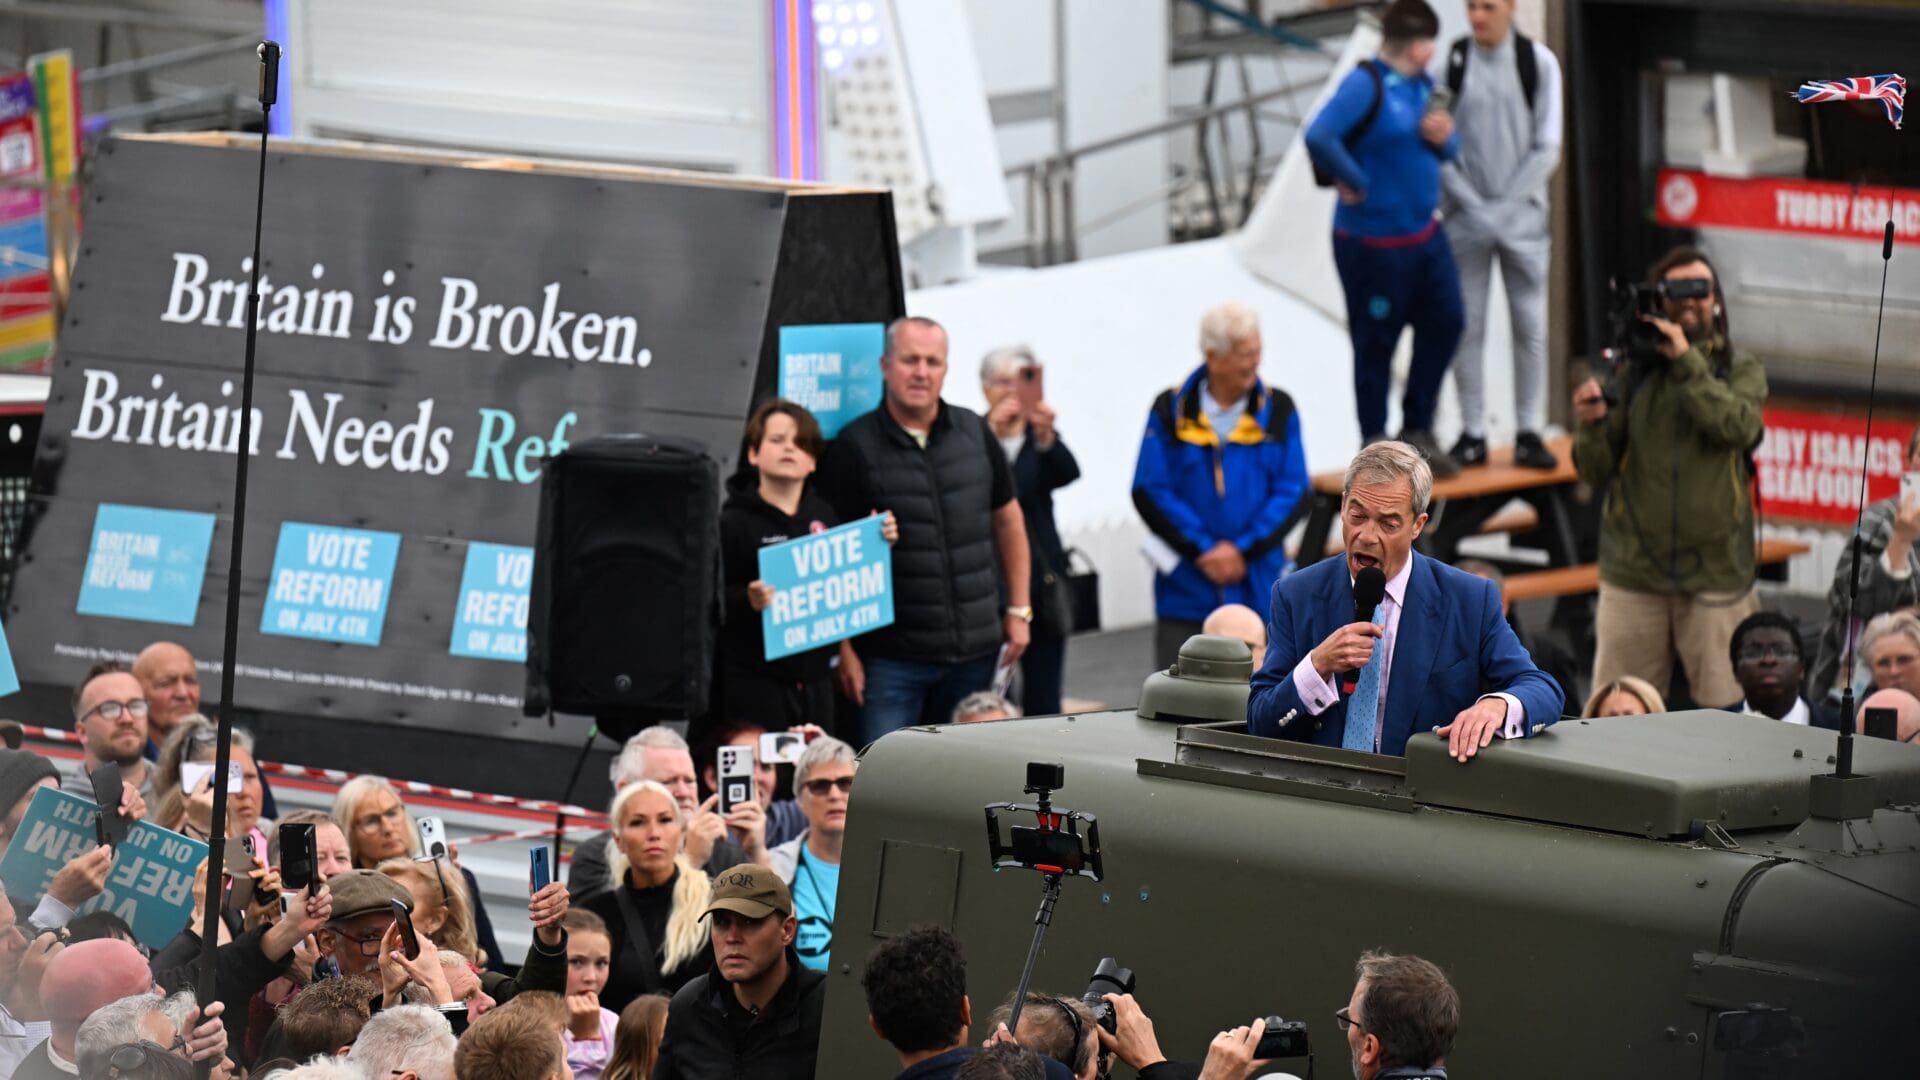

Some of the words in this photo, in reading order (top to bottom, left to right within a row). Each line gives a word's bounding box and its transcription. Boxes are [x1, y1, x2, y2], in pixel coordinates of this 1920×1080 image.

[1774, 188, 1849, 230] TUBBY
[160, 252, 354, 340] Britain
[367, 269, 416, 345] is
[429, 276, 653, 368] Broken.
[785, 352, 843, 375] BRITAIN
[71, 368, 264, 457] Britain
[276, 389, 454, 476] Needs
[466, 407, 578, 485] Ref
[97, 530, 161, 558] BRITAIN
[306, 531, 373, 571] VOTE
[791, 528, 864, 578] VOTE
[88, 568, 155, 592] REFORM
[495, 552, 532, 588] VO
[274, 568, 384, 613] REFORM
[463, 589, 531, 629] REFO
[771, 560, 885, 625] REFORM
[277, 608, 300, 630] ON
[301, 612, 337, 635] JULY
[338, 615, 369, 638] 4TH
[467, 630, 491, 651] ON
[784, 624, 807, 648] ON
[810, 613, 847, 642] JULY
[851, 602, 880, 628] 4TH
[126, 826, 158, 849] JU
[159, 838, 193, 864] ON
